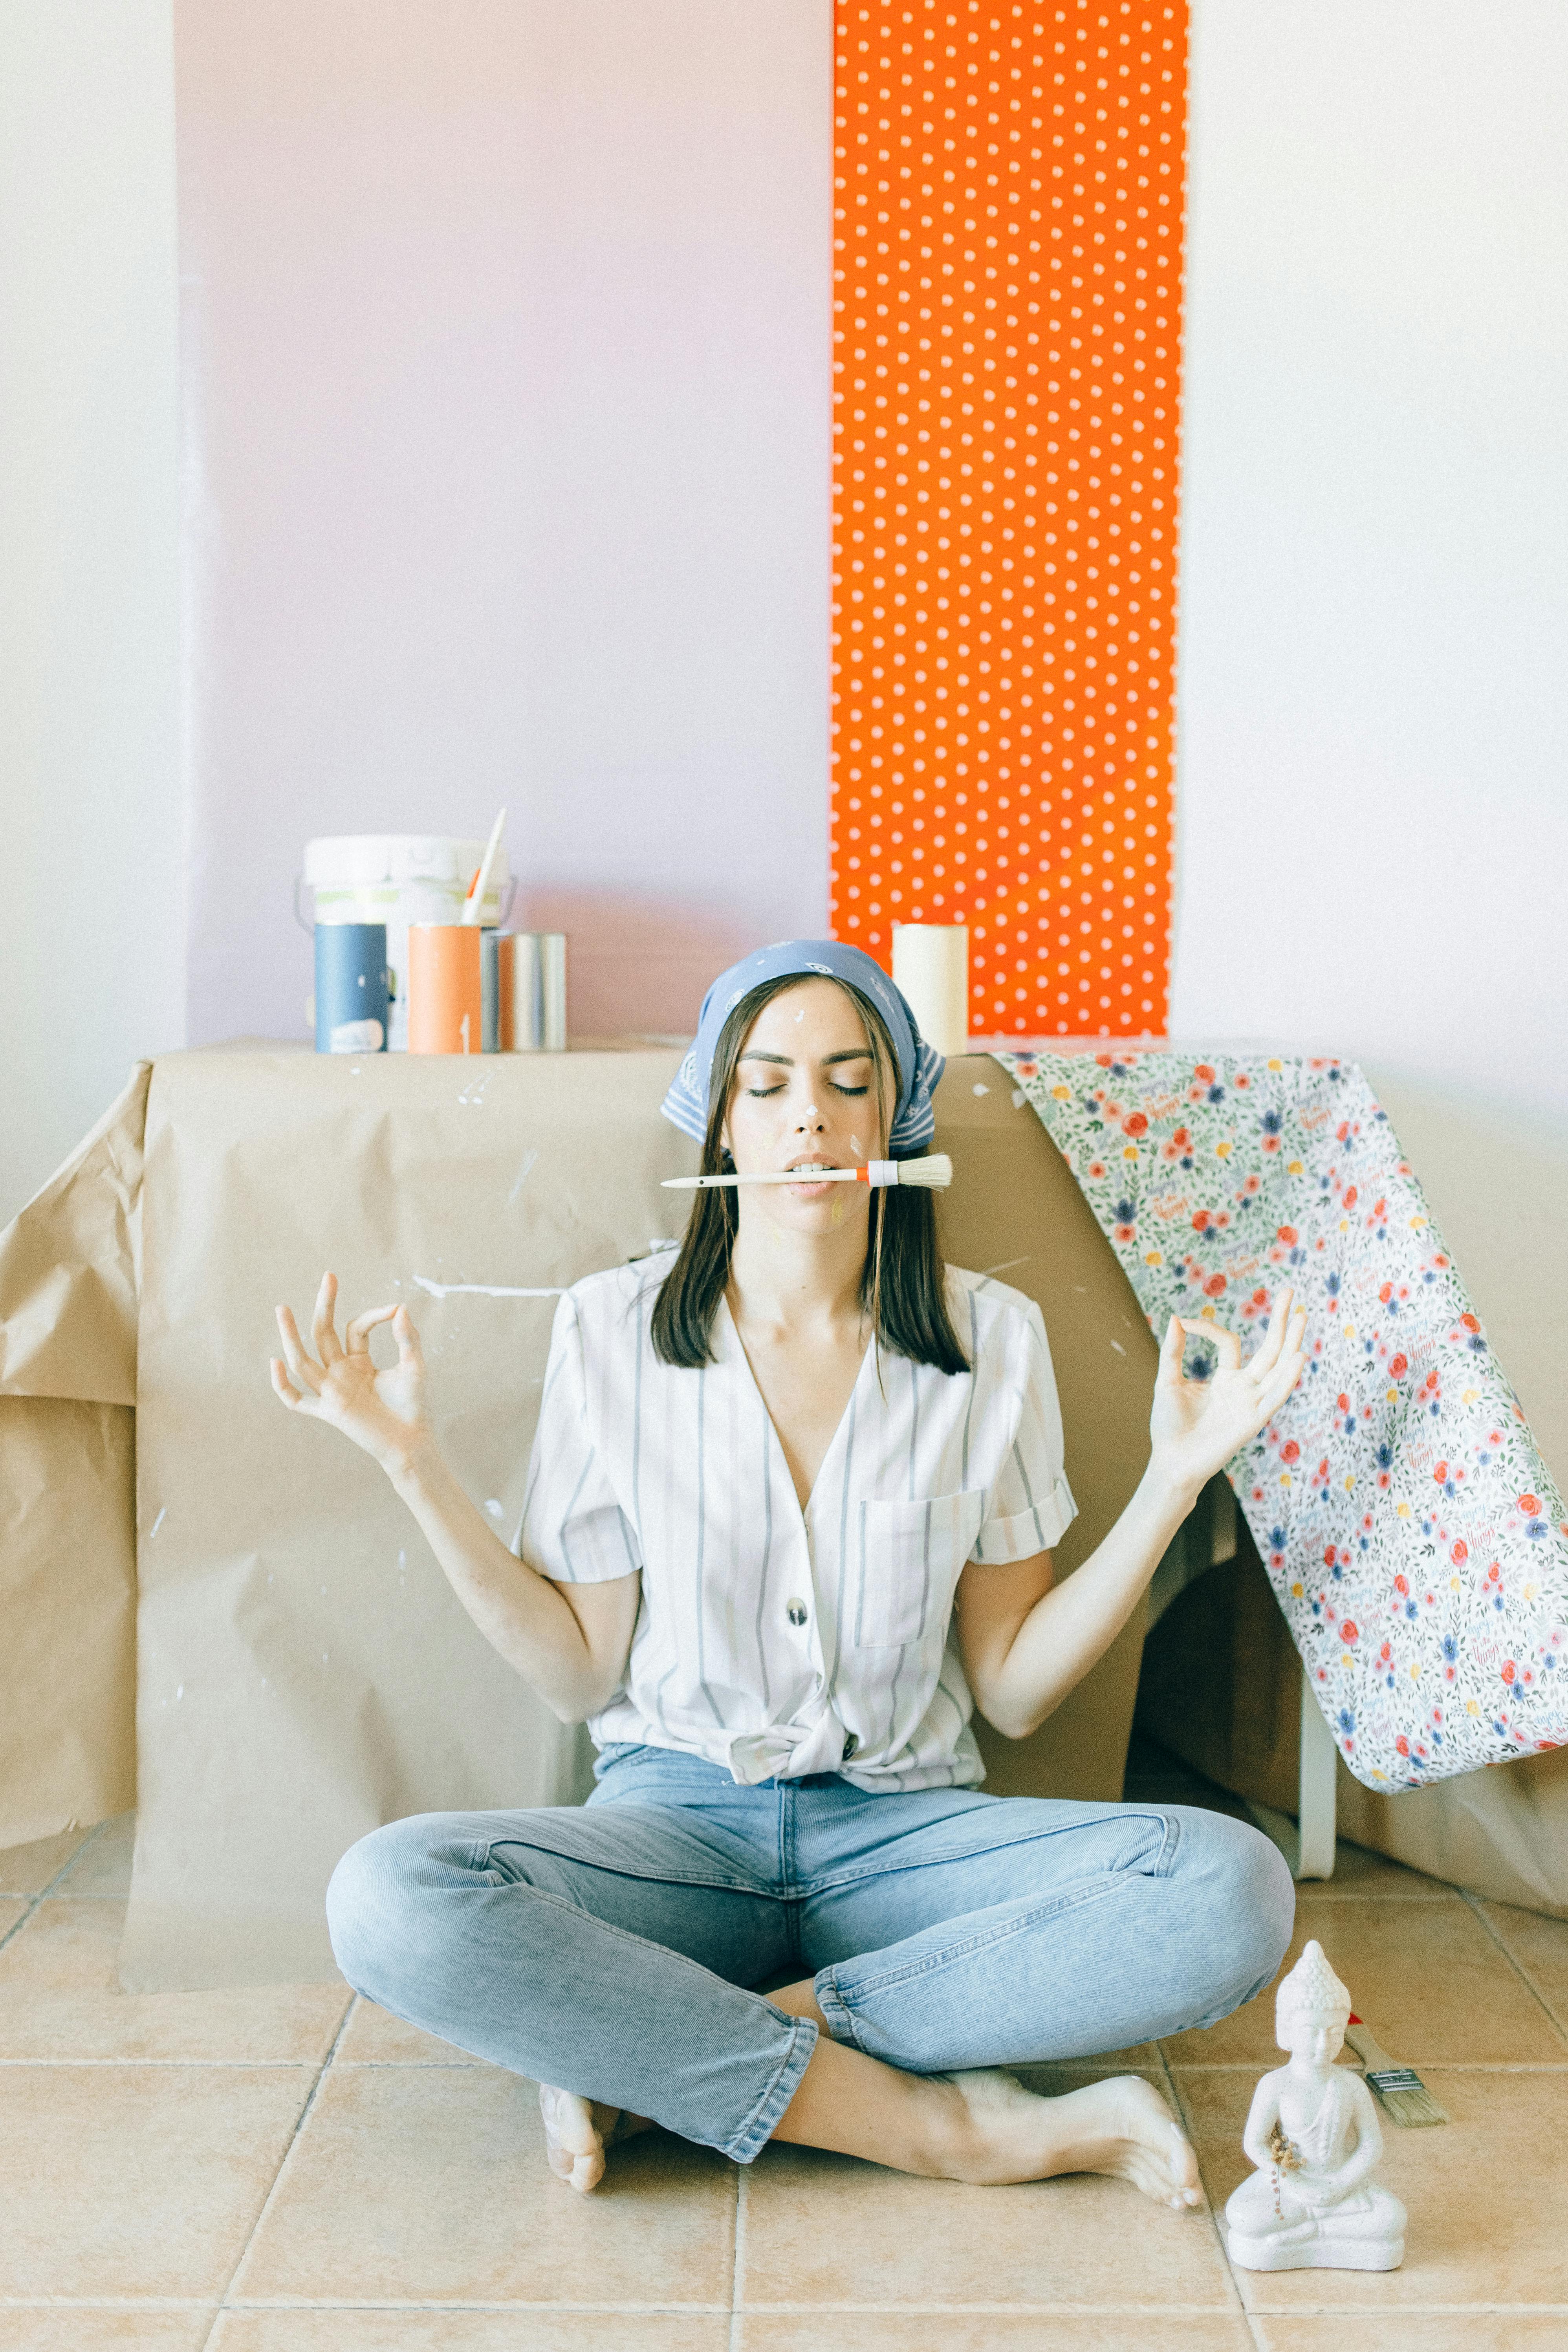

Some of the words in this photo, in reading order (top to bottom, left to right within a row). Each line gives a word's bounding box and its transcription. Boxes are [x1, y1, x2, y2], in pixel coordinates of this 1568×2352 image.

[1465, 1523, 1499, 1549] things
[1466, 1619, 1494, 1640] enjoy
[1471, 1639, 1503, 1667] things
[1534, 1709, 1564, 1729] enjoy
